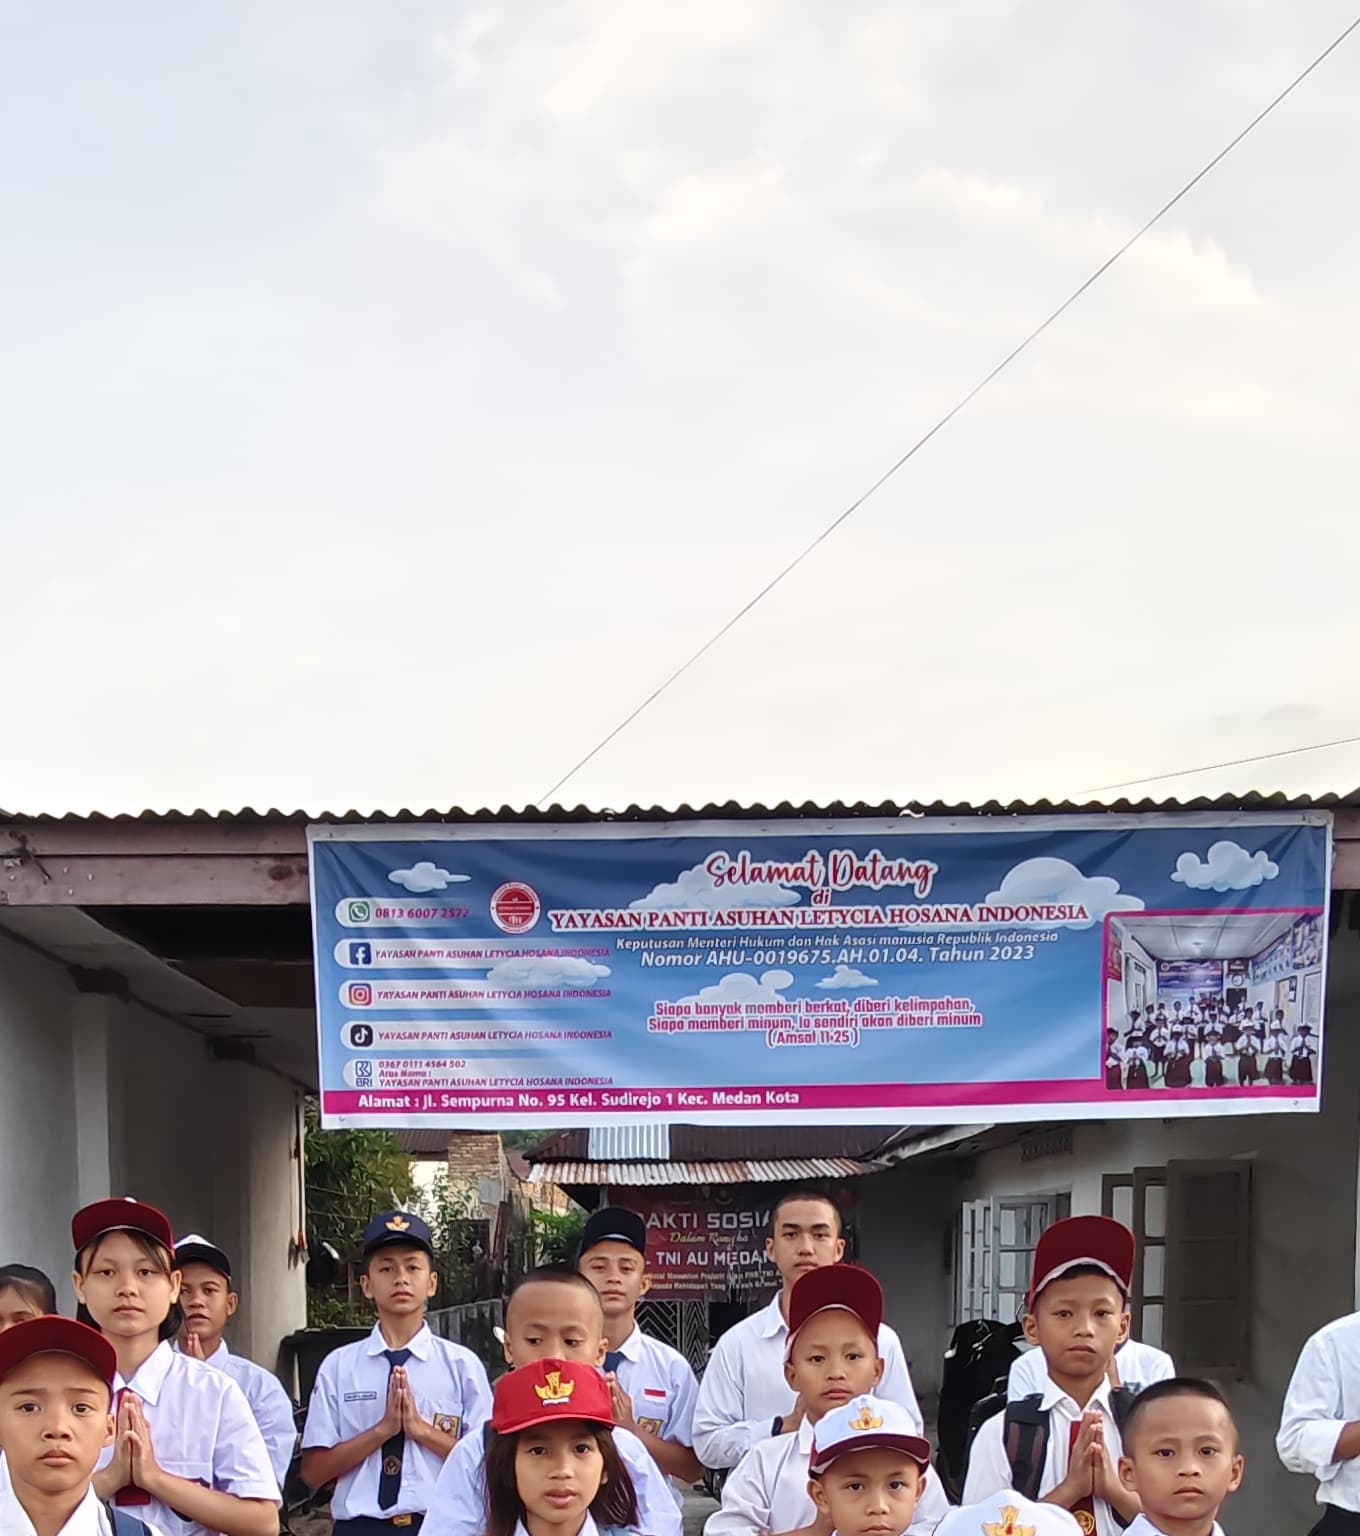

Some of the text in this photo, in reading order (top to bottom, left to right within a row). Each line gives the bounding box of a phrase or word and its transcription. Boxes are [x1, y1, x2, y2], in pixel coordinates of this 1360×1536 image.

[706, 852, 935, 897] Selamat Datang
[812, 889, 831, 905] di
[375, 907, 405, 918] 0813
[407, 907, 437, 918] 6007
[551, 904, 1089, 929] YAYASAN PANTI ASUHAN LETYCIA HOSANA INDONESIA
[616, 931, 1058, 951] Keputusan Menteri Hukum dan Hak Asasi manusia Republik Indonesia
[375, 949, 416, 959] YAYASAN
[417, 949, 444, 959] PANTI
[446, 949, 483, 959] ASUHAN
[641, 952, 702, 966] Nomor
[930, 947, 985, 962] Tahun
[989, 946, 1034, 960] 2023
[377, 989, 611, 999] YAYASAN PANTI ASUHAN LETYCIA HOSANA INDONESIA
[656, 998, 975, 1017] Siapa banyak memberi berkat, diberi kelimpahan,
[649, 1019, 685, 1032] Siapa
[688, 1018, 744, 1030] memberi
[748, 1018, 795, 1031] minum,
[814, 1016, 859, 1029] sendiri
[862, 1016, 893, 1028] akan
[897, 1014, 933, 1027] diberi
[937, 1013, 981, 1026] minum
[378, 1029, 612, 1041] YAYASAN PANTI ASUHAN LETYCIA HOSANA INDONESIA
[356, 1078, 373, 1088] BRI
[379, 1077, 613, 1088] YAYASAN PANTI ASUHAN LETYCIA HOSANA INDONESIA
[358, 1094, 411, 1108] Alamat
[422, 1094, 436, 1110] Jl.
[440, 1094, 514, 1110] Sempurna
[519, 1093, 543, 1107] No.
[547, 1094, 565, 1106] 95
[570, 1093, 597, 1106] Kel.
[601, 1092, 661, 1109] Sudirejo
[666, 1093, 673, 1105] 1
[678, 1093, 709, 1105] Kec.
[712, 1092, 761, 1105] Medan
[765, 1091, 800, 1104] Kota
[656, 1252, 681, 1265] TNI
[686, 1251, 708, 1265] AU
